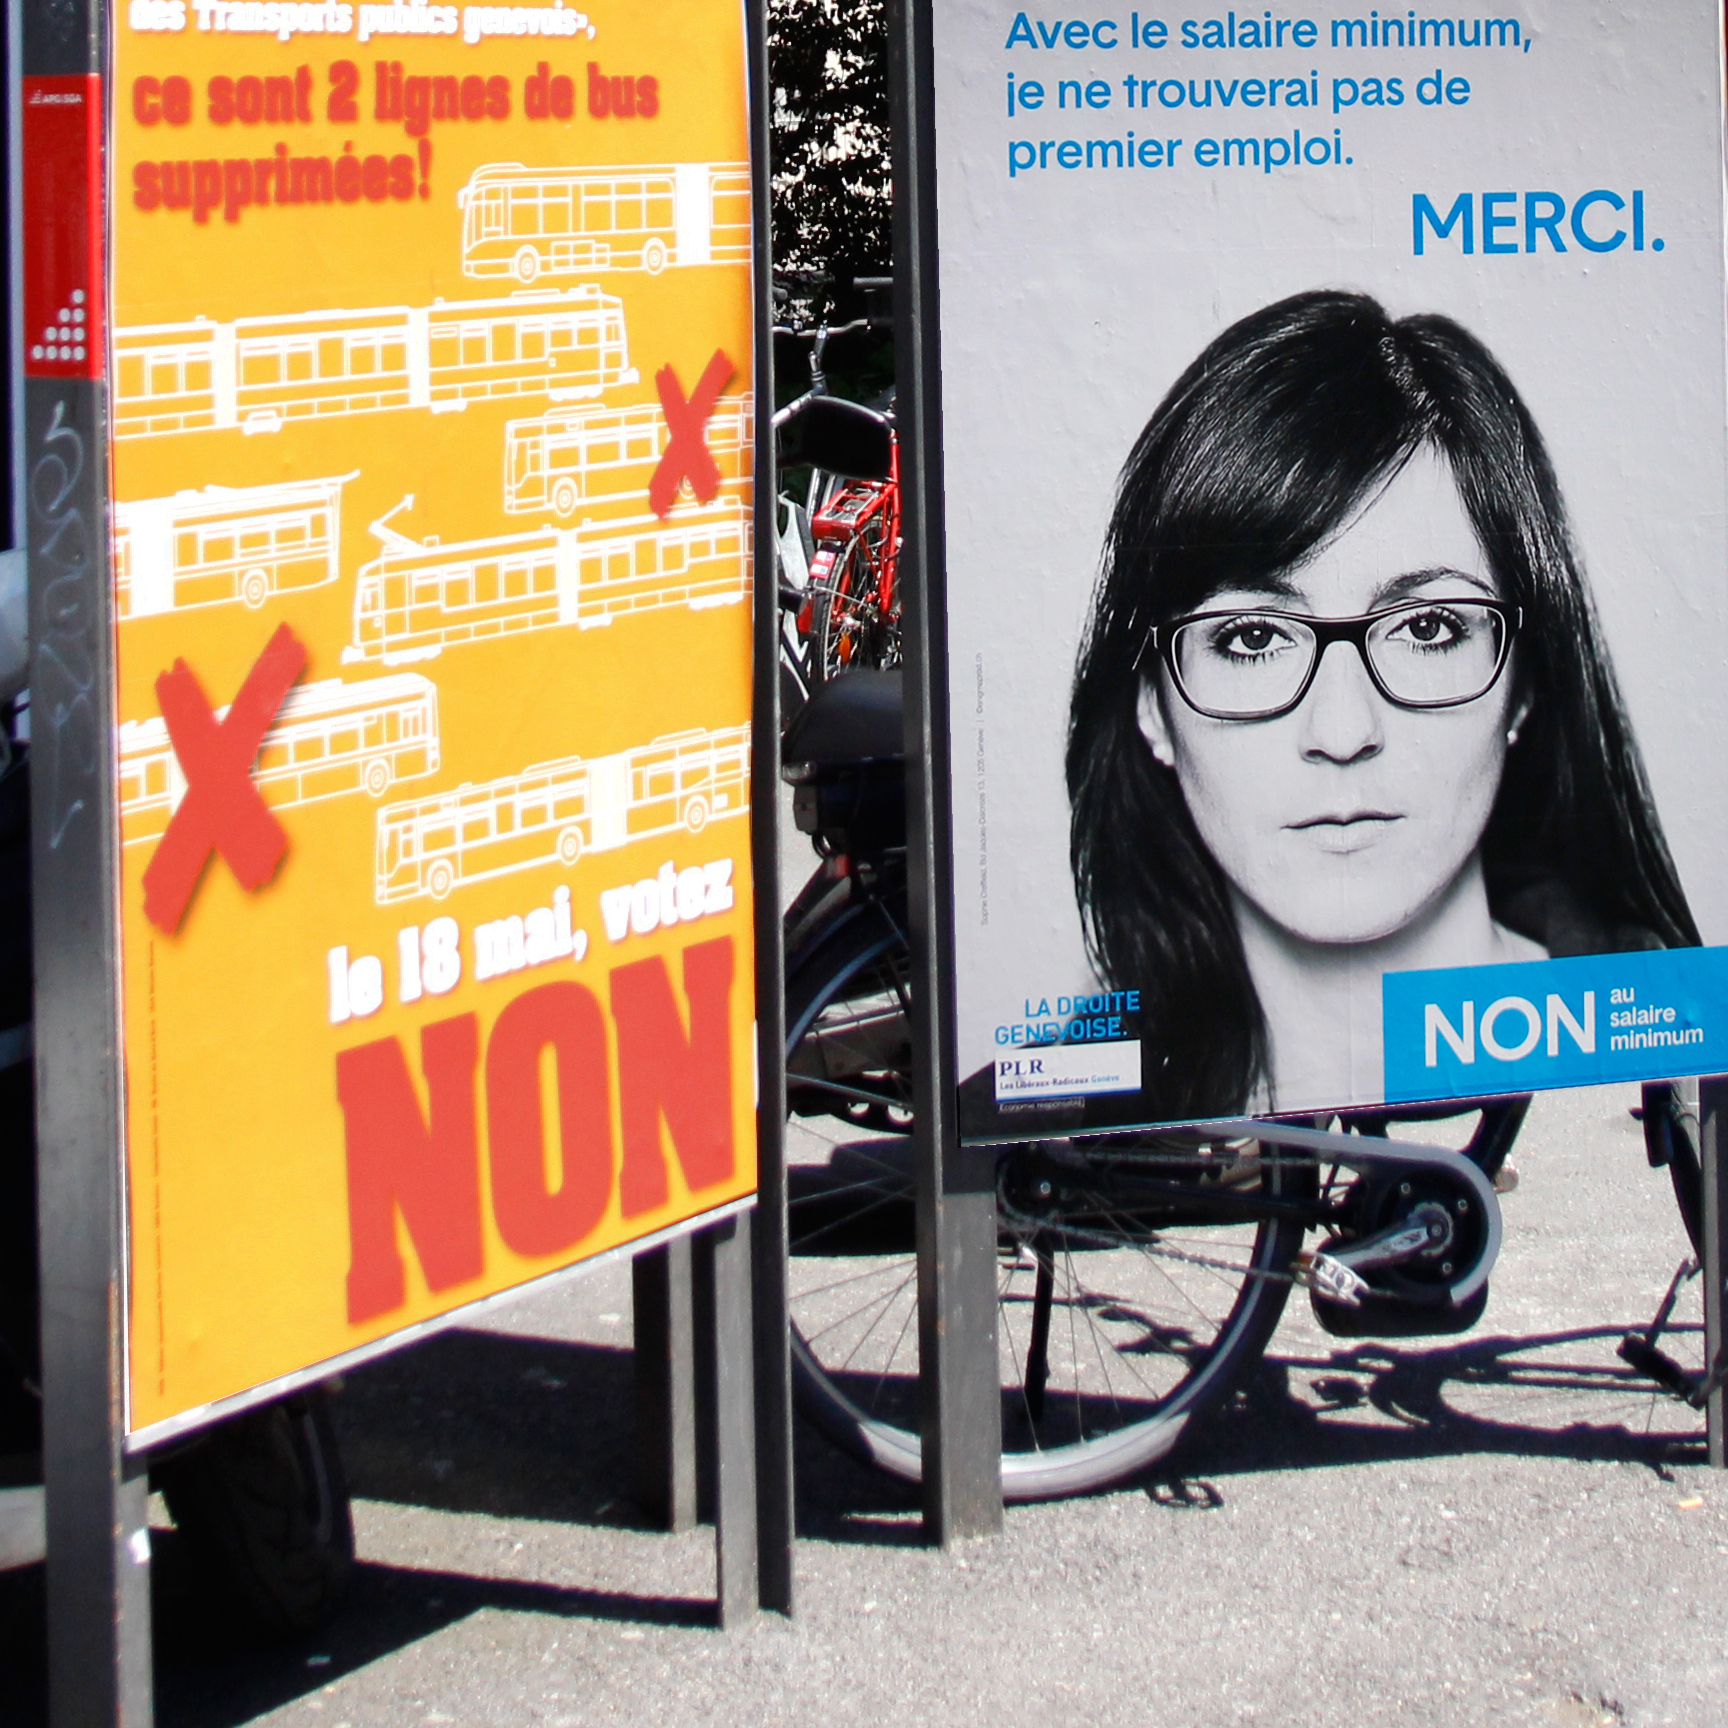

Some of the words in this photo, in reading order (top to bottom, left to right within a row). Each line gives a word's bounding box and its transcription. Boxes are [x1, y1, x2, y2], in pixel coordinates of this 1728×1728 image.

[464, 0, 596, 43] genevois»,
[1005, 12, 1118, 50] Avec
[1130, 12, 1168, 49] le
[1180, 10, 1318, 49] salaire
[1330, 9, 1532, 54] minimum,
[132, 73, 192, 125] ce
[207, 64, 313, 125] sont
[327, 59, 362, 124] 2
[374, 60, 511, 138] lignes
[524, 61, 573, 120] de
[586, 61, 660, 119] bus
[1005, 72, 1045, 118] je
[1058, 77, 1111, 109] ne
[1122, 69, 1319, 108] trouverai
[1331, 75, 1405, 114] pas
[1416, 68, 1472, 106] de
[1008, 133, 1182, 178] premier
[1194, 128, 1354, 174] emploi.
[132, 137, 433, 225] supprimées!
[1411, 189, 1666, 255] MERCI.
[327, 947, 383, 1025] le
[399, 914, 461, 1004] 18
[474, 885, 589, 983] mai,
[599, 859, 734, 942] votez
[1025, 998, 1051, 1019] LA
[1057, 990, 1141, 1016] DROITE
[1609, 986, 1635, 1004] au
[1609, 1004, 1676, 1028] salaire
[994, 1016, 1129, 1046] GENEVOISE.
[1423, 991, 1596, 1069] NON
[1609, 1025, 1704, 1052] minimum
[999, 1058, 1045, 1078] PLR
[999, 1080, 1014, 1091] Les
[1015, 1075, 1090, 1090] Libéraux-Radicaux
[335, 936, 736, 1327] NON
